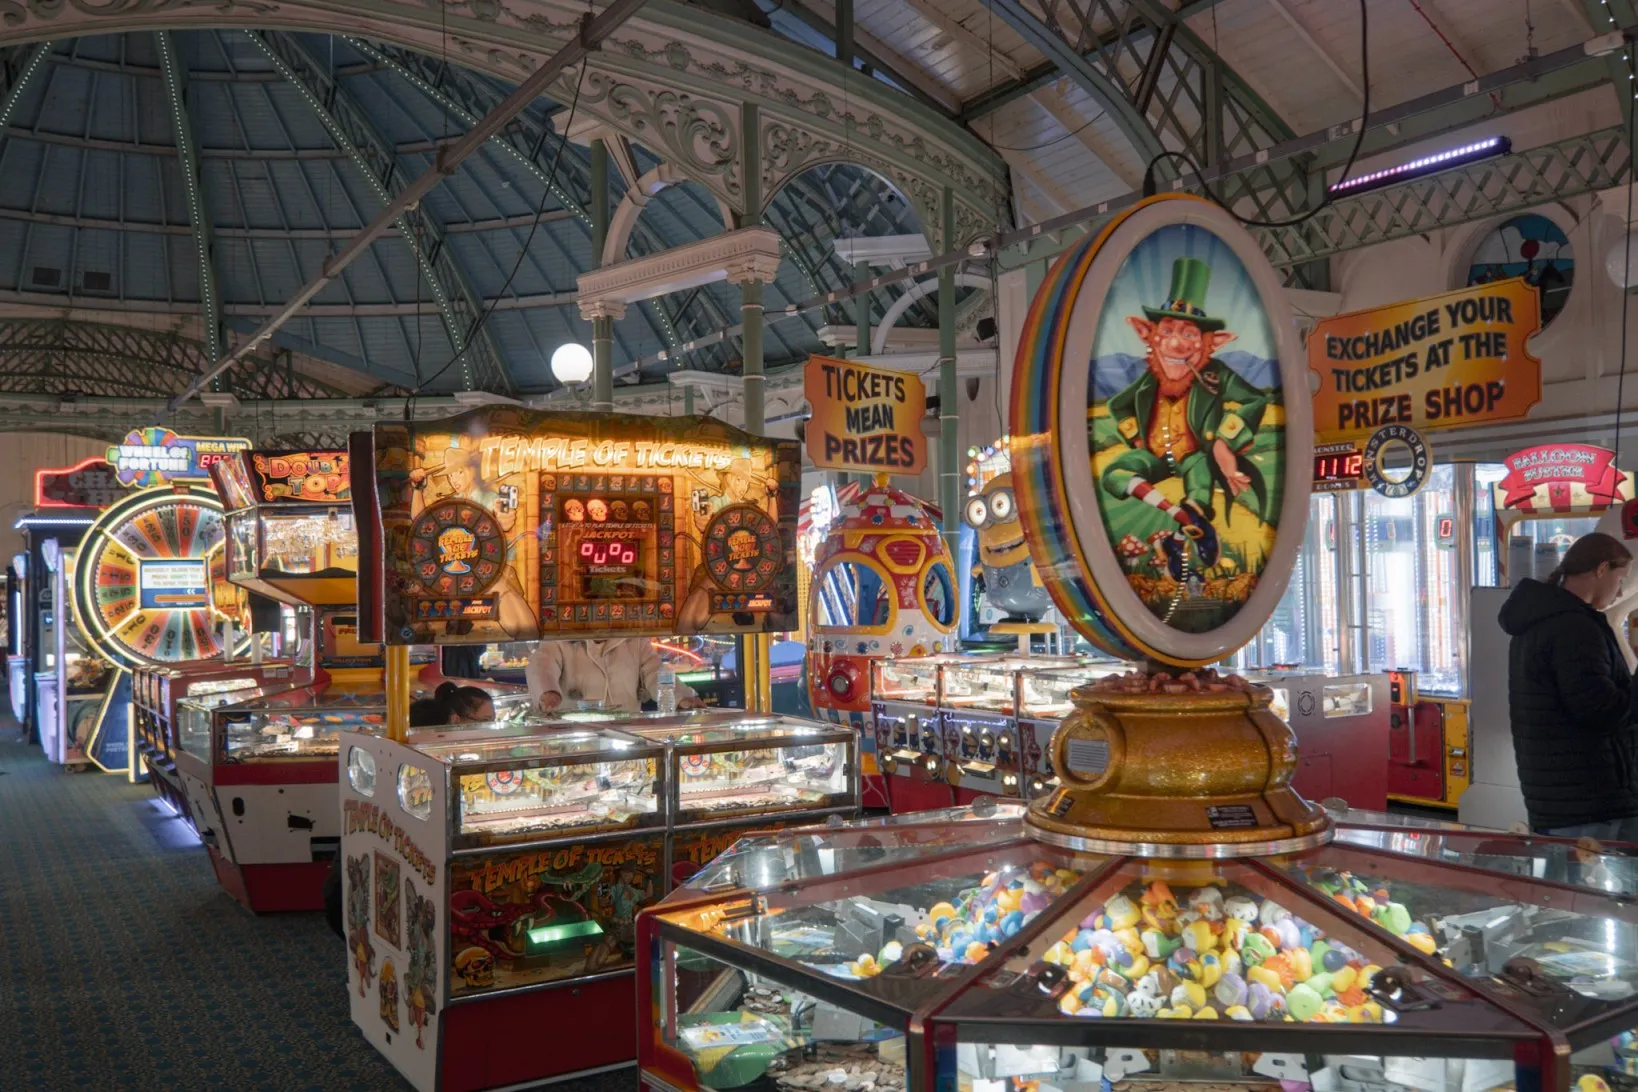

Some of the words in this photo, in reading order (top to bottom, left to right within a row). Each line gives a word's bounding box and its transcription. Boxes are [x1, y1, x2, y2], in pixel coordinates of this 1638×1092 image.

[1326, 308, 1440, 360] EXCHANGE
[1445, 297, 1514, 328] YOUR
[1331, 352, 1419, 392] TICKETS
[1424, 339, 1453, 372] AT
[1458, 332, 1507, 360] THE
[821, 364, 906, 403] TICKETS
[1338, 394, 1412, 430] PRIZE
[1425, 381, 1504, 420] SHOP
[845, 404, 894, 434] MEAN
[119, 445, 169, 458] WHEEL
[196, 442, 226, 452] MEGA
[226, 442, 247, 452] WIN
[479, 436, 589, 480] TEMPLE
[592, 440, 630, 466] OF
[635, 442, 733, 470] TICKETS
[824, 431, 915, 467] PRIZES
[1512, 448, 1596, 470] BALLOON
[119, 457, 188, 471] FORTUNE
[1524, 466, 1584, 481] BUSTER
[288, 474, 342, 495] TOP
[583, 531, 635, 539] JACKPOT
[589, 565, 627, 573] Tickets
[462, 605, 492, 614] JACKPOT
[344, 799, 379, 834] TEMPLE
[379, 811, 393, 842] OF
[394, 826, 436, 886] TICKETS
[471, 850, 549, 893] TEMPLE
[553, 845, 584, 869] OF
[588, 843, 657, 866] TICKETS
